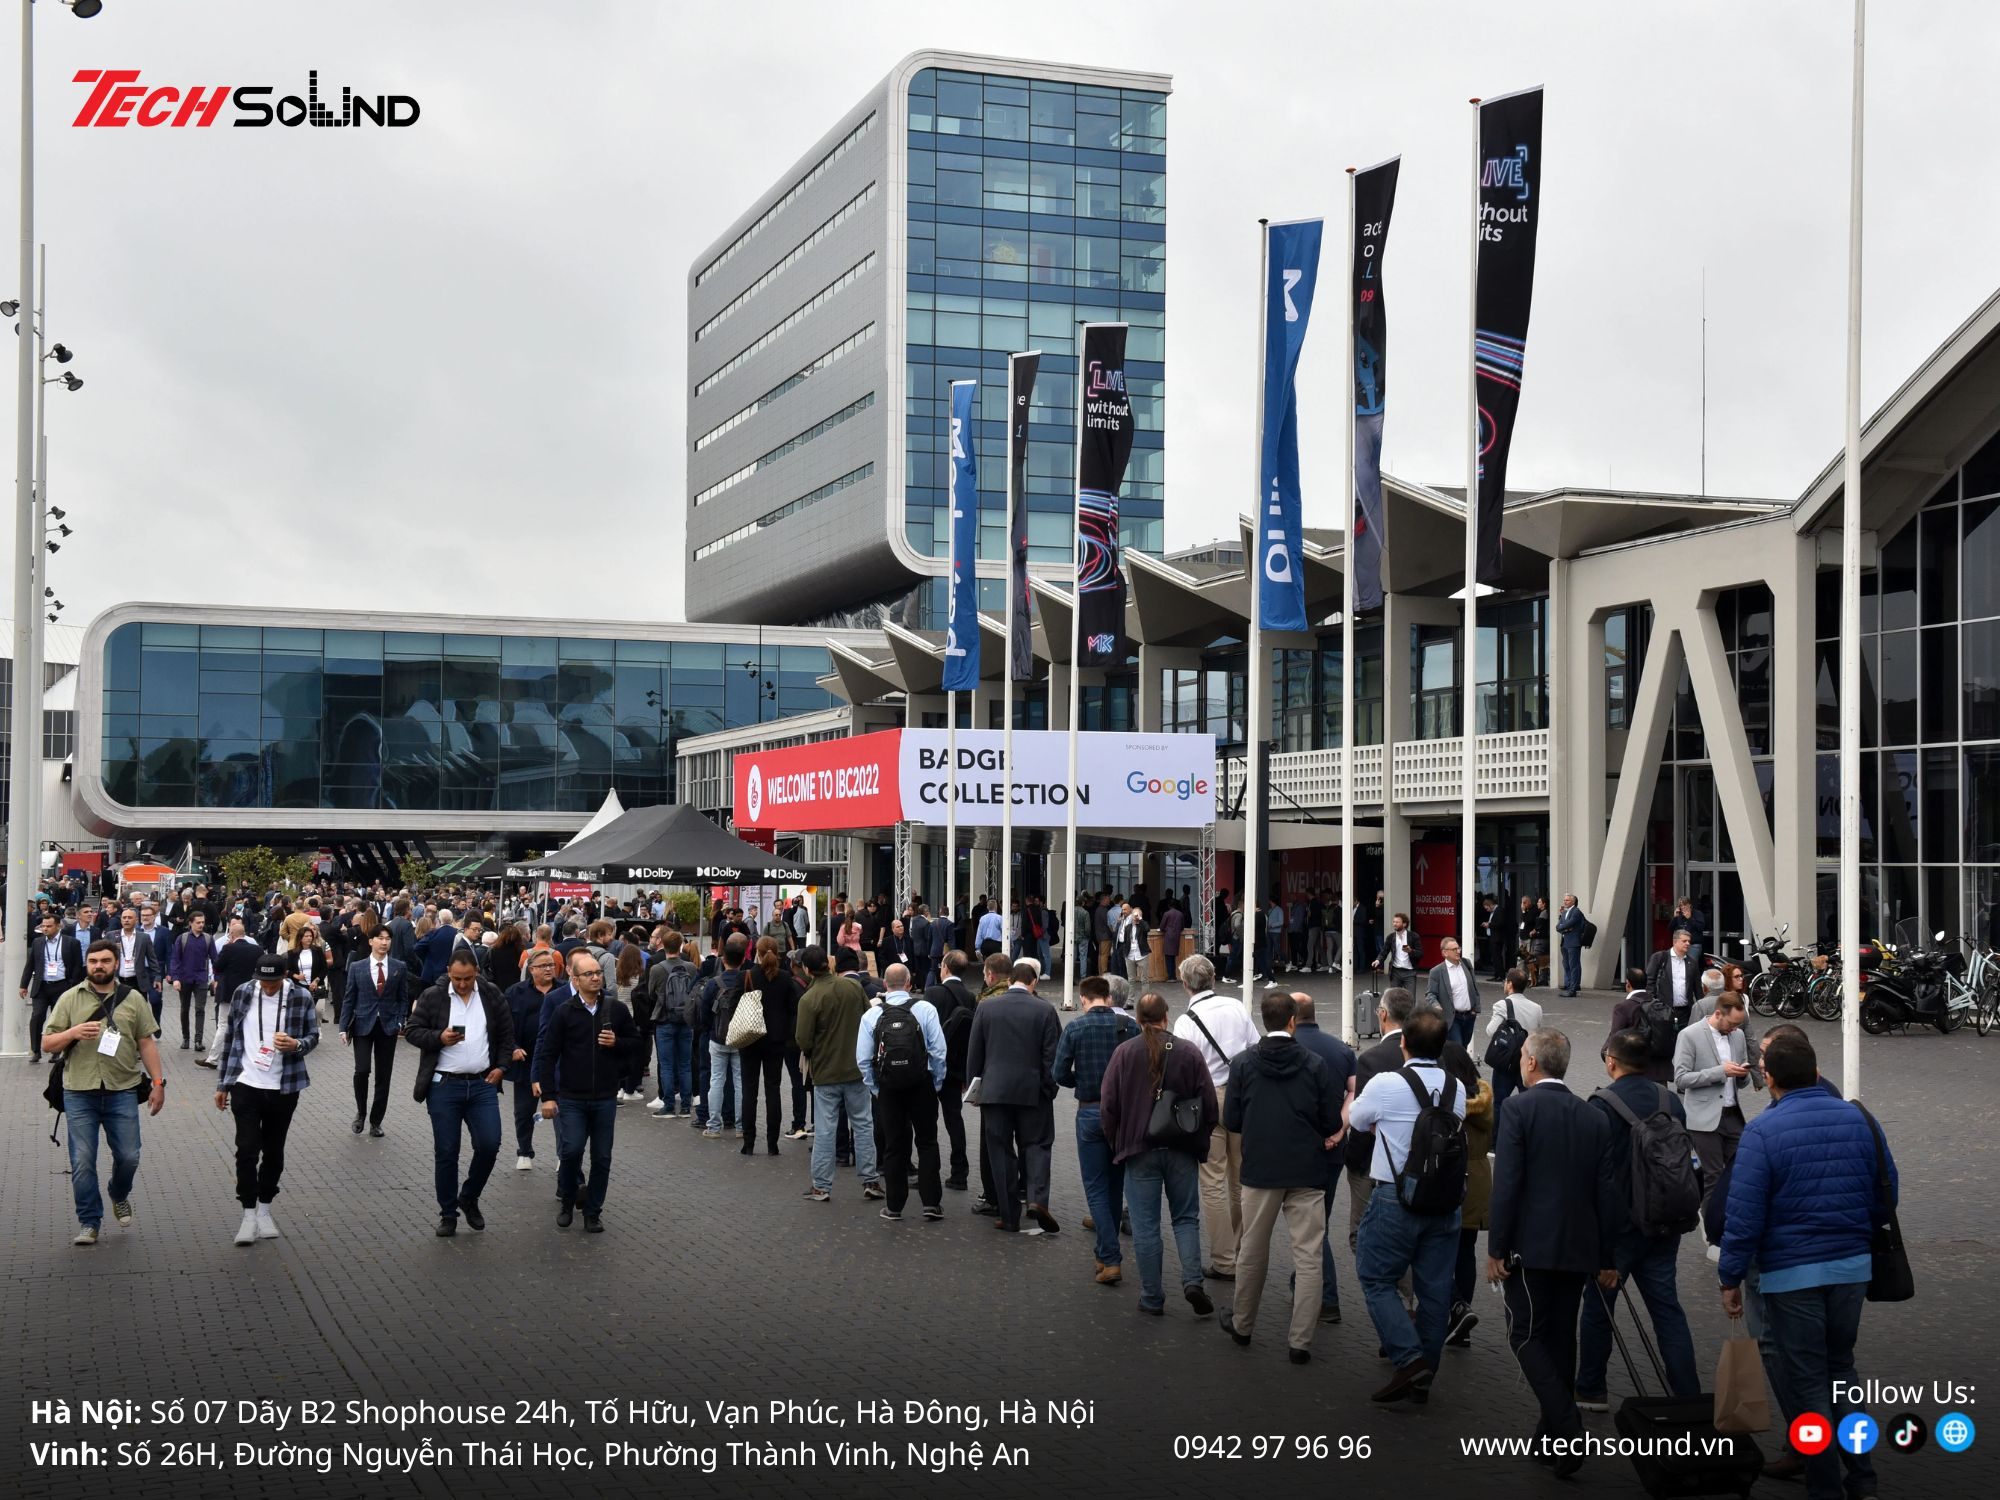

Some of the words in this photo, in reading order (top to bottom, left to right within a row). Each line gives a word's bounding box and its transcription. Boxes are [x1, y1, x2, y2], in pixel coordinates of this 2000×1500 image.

[1481, 158, 1524, 187] IVE
[1480, 202, 1528, 223] thout
[1480, 223, 1503, 242] its
[1087, 400, 1129, 417] without
[1087, 414, 1120, 431] limits
[768, 772, 816, 805] WELCOME
[818, 769, 833, 800] TO
[836, 763, 880, 799] IBC2022
[1126, 770, 1209, 801] Google
[919, 782, 1091, 805] COLLECTION
[644, 867, 675, 880] Dolby
[711, 866, 742, 880] Dolby
[778, 868, 808, 882] Dolby
[1433, 895, 1452, 904] HOLDER
[1415, 906, 1428, 915] ONLY
[1429, 906, 1455, 915] ENTRANCE
